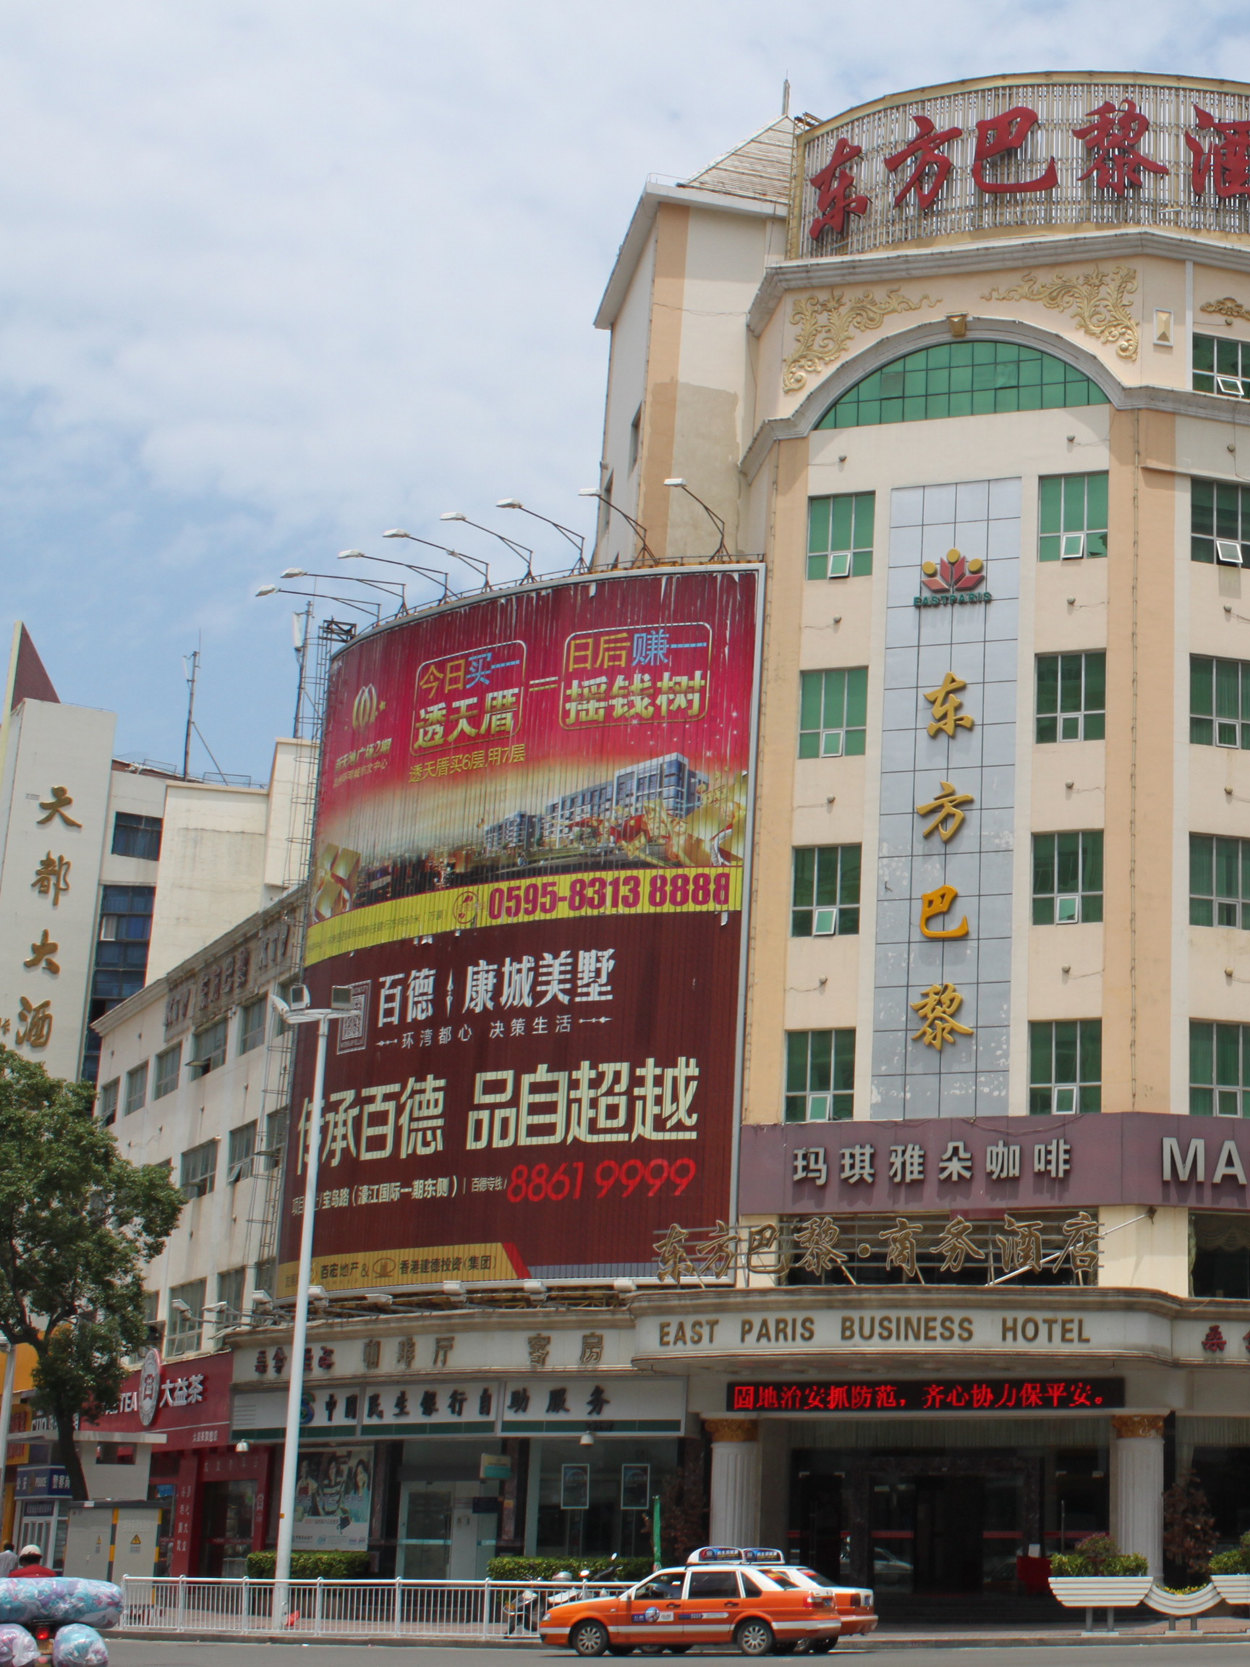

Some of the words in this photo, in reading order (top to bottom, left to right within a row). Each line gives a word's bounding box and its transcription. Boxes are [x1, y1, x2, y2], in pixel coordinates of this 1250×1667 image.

[565, 670, 706, 726] 摇钱树
[910, 671, 974, 1051] 东方巴黎
[488, 876, 641, 920] 0595-8313
[648, 872, 730, 908] 8888
[377, 967, 437, 1028] 百德
[461, 948, 617, 1015] 康城美墅
[401, 1023, 473, 1049] 环湾都心
[489, 1015, 572, 1040] 决策生活
[466, 1056, 700, 1150] 品自超越
[507, 1160, 584, 1203] 8861
[594, 1157, 697, 1198] 9999
[793, 1138, 1072, 1186] 玛琪雅朵咖啡
[527, 1332, 605, 1367] 客房
[659, 1318, 719, 1346] EAST
[740, 1316, 816, 1343] PARIS
[840, 1315, 974, 1343] BUSINESS
[1001, 1316, 1092, 1344] HOTEL
[160, 1373, 204, 1408] 大益茶
[325, 1385, 611, 1422] 中国民生银行自助服务
